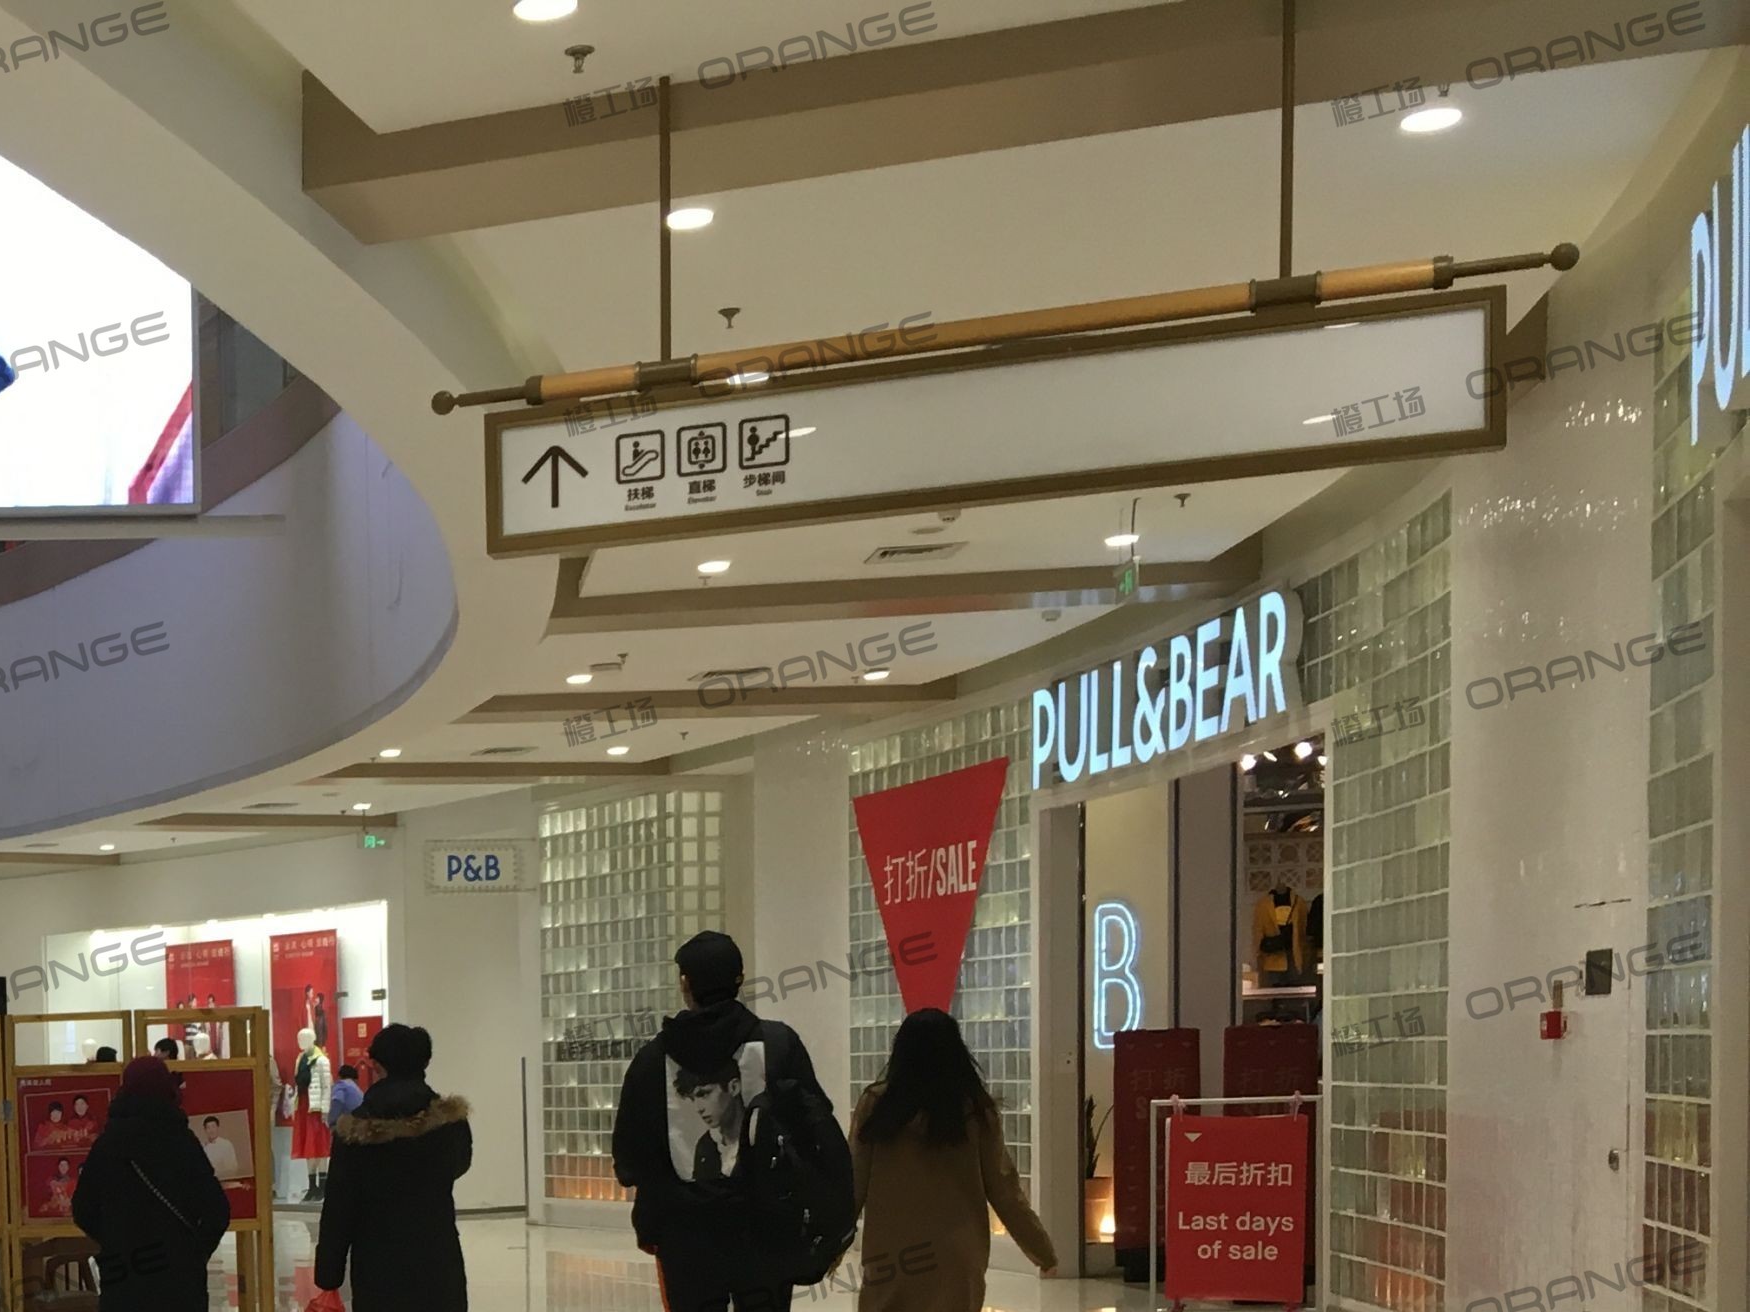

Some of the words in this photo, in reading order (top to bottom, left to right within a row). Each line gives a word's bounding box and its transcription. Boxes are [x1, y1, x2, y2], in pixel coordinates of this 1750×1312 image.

[688, 479, 716, 495] 直梯
[743, 470, 785, 488] 步梯间
[627, 486, 654, 501] 扶梯
[1032, 591, 1287, 790] PULL&BEAR
[447, 854, 500, 882] P&B
[1094, 903, 1141, 1048] B
[1185, 1161, 1292, 1186] 最后折扣
[1178, 1211, 1229, 1230] Last
[1235, 1211, 1294, 1236] days
[1197, 1240, 1222, 1259] of
[1228, 1240, 1278, 1261] sale
